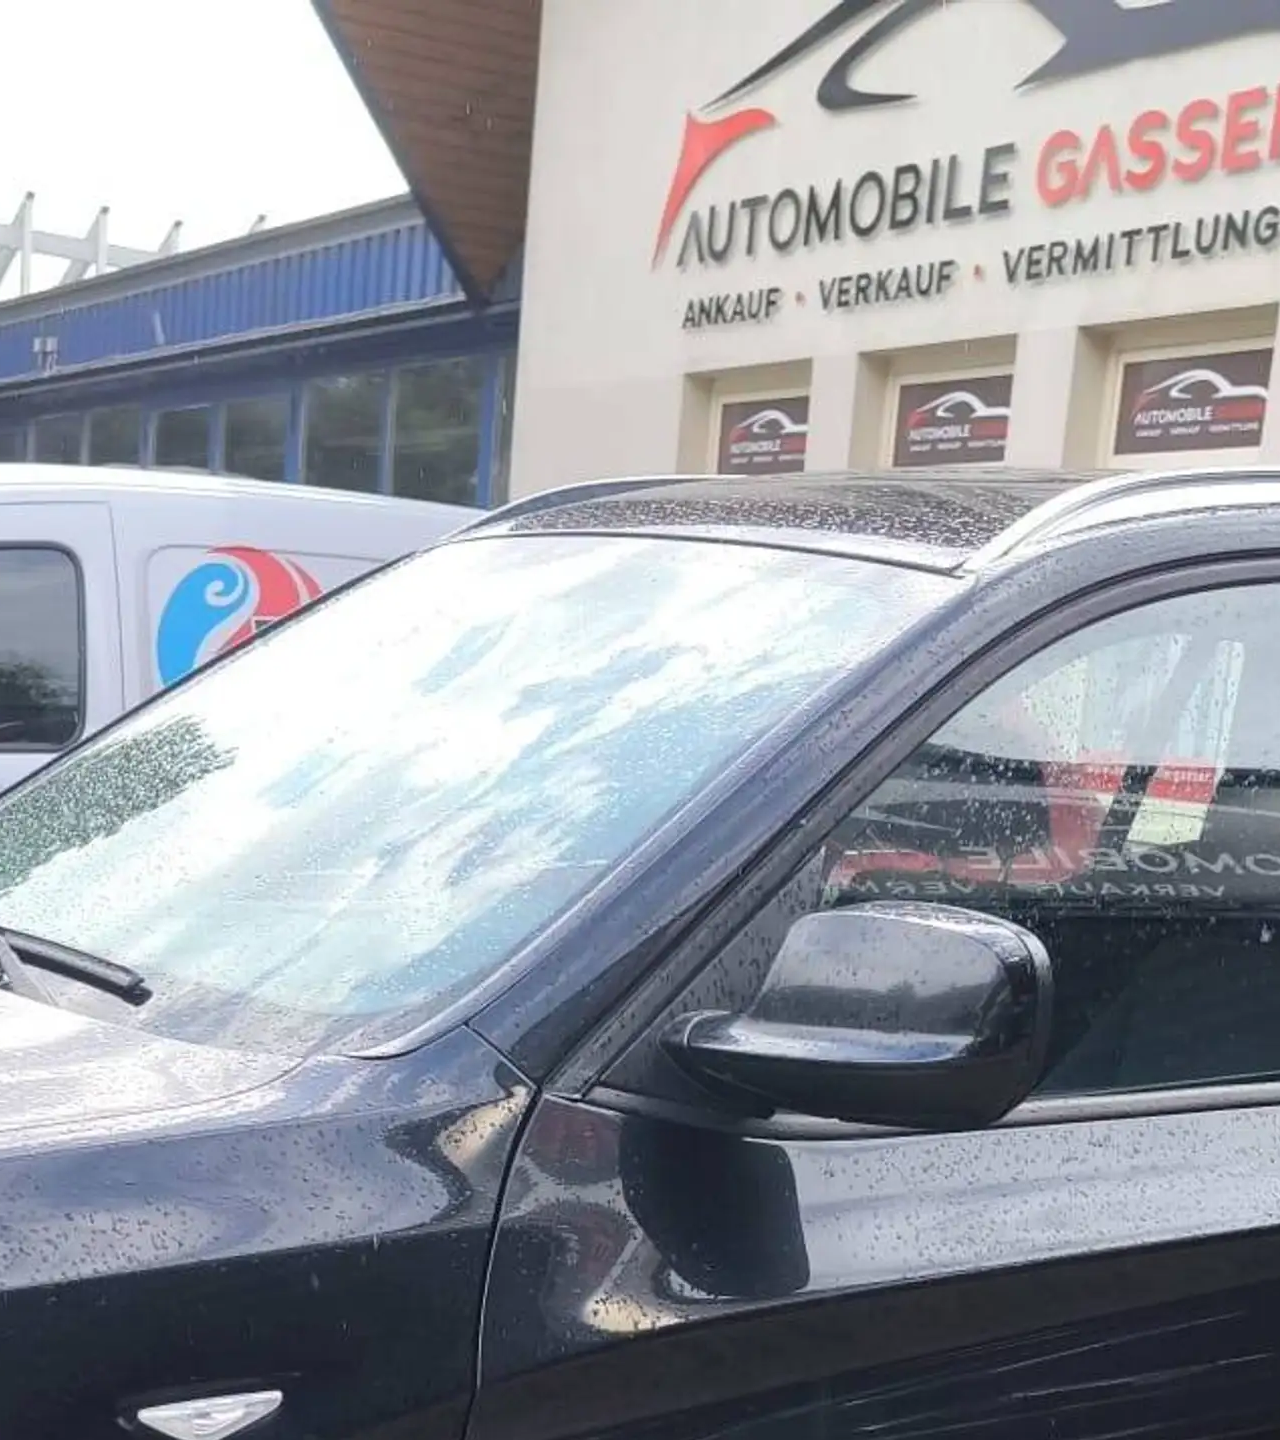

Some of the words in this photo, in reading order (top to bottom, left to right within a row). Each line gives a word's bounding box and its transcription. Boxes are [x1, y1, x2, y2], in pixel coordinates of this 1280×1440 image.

[676, 142, 1016, 267] AUTOMOBILE
[682, 287, 781, 329] ANKAUF
[819, 259, 955, 310] VERKAUF
[1003, 205, 1280, 284] VERMITTLUNG
